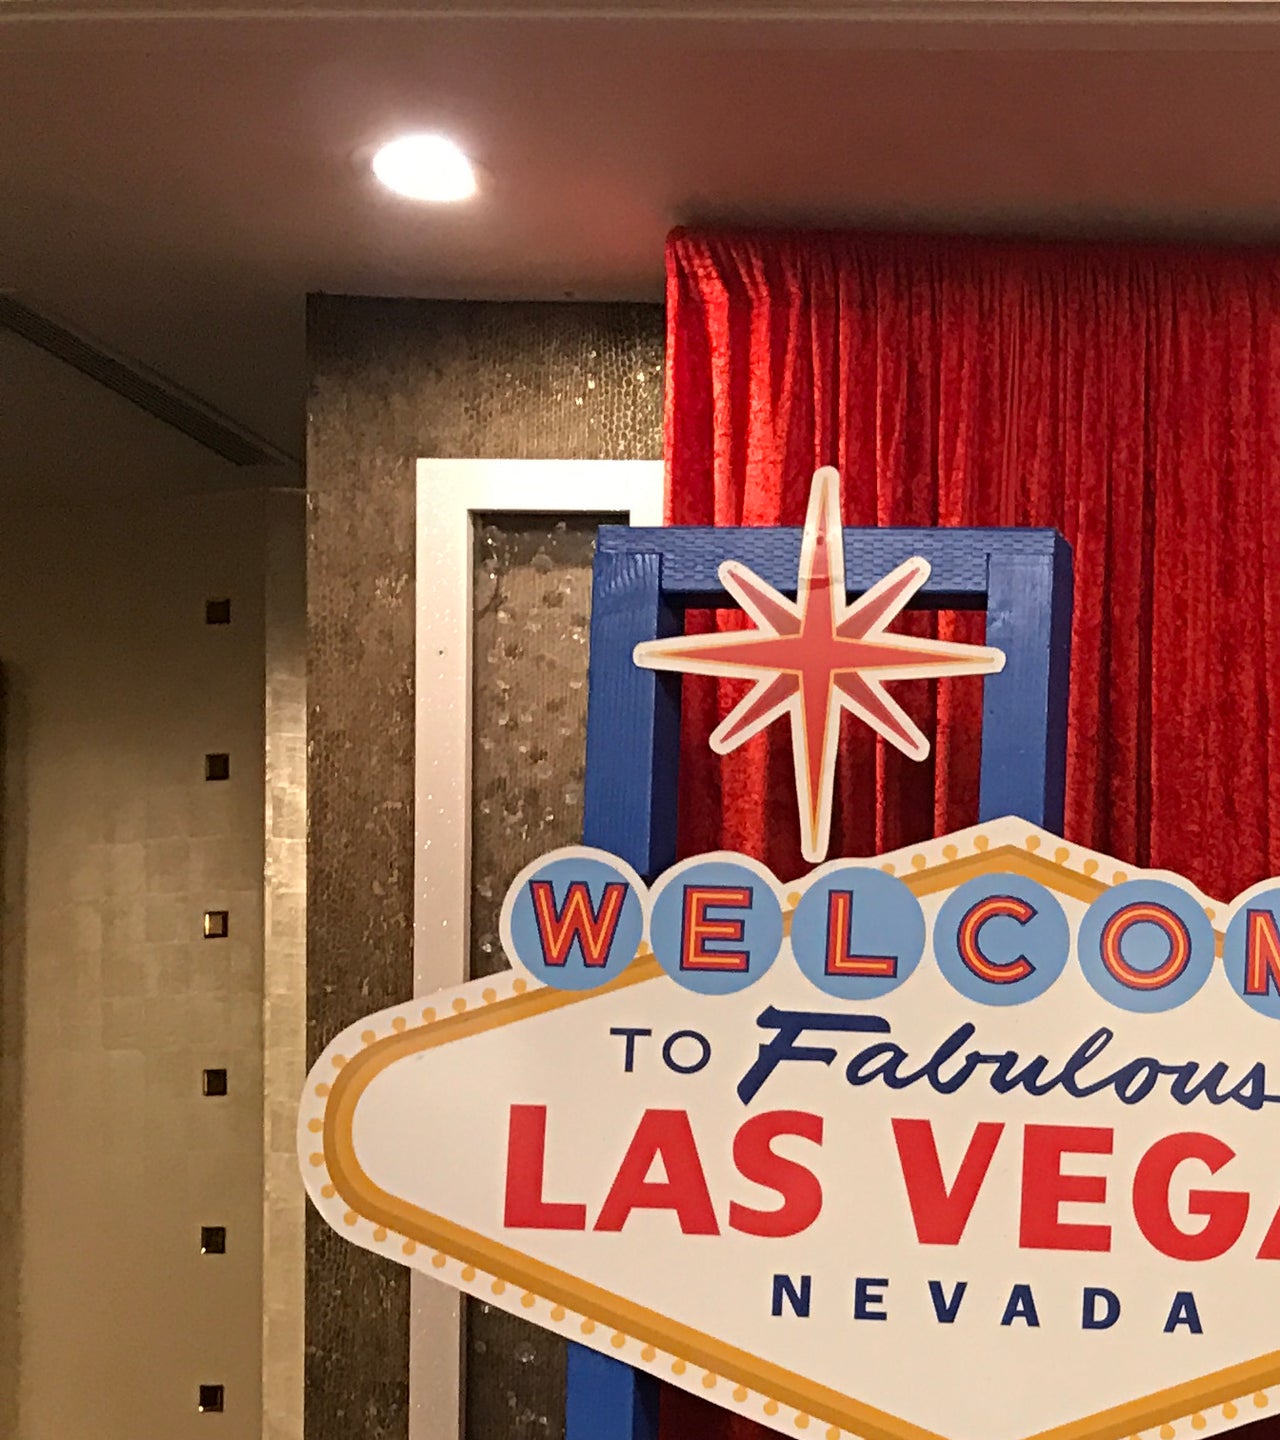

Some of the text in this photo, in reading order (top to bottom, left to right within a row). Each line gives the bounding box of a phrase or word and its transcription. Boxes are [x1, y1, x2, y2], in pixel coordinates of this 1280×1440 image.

[609, 1027, 712, 1075] TO
[503, 1104, 824, 1238] LAS
[770, 1273, 1204, 1334] NEVADA
